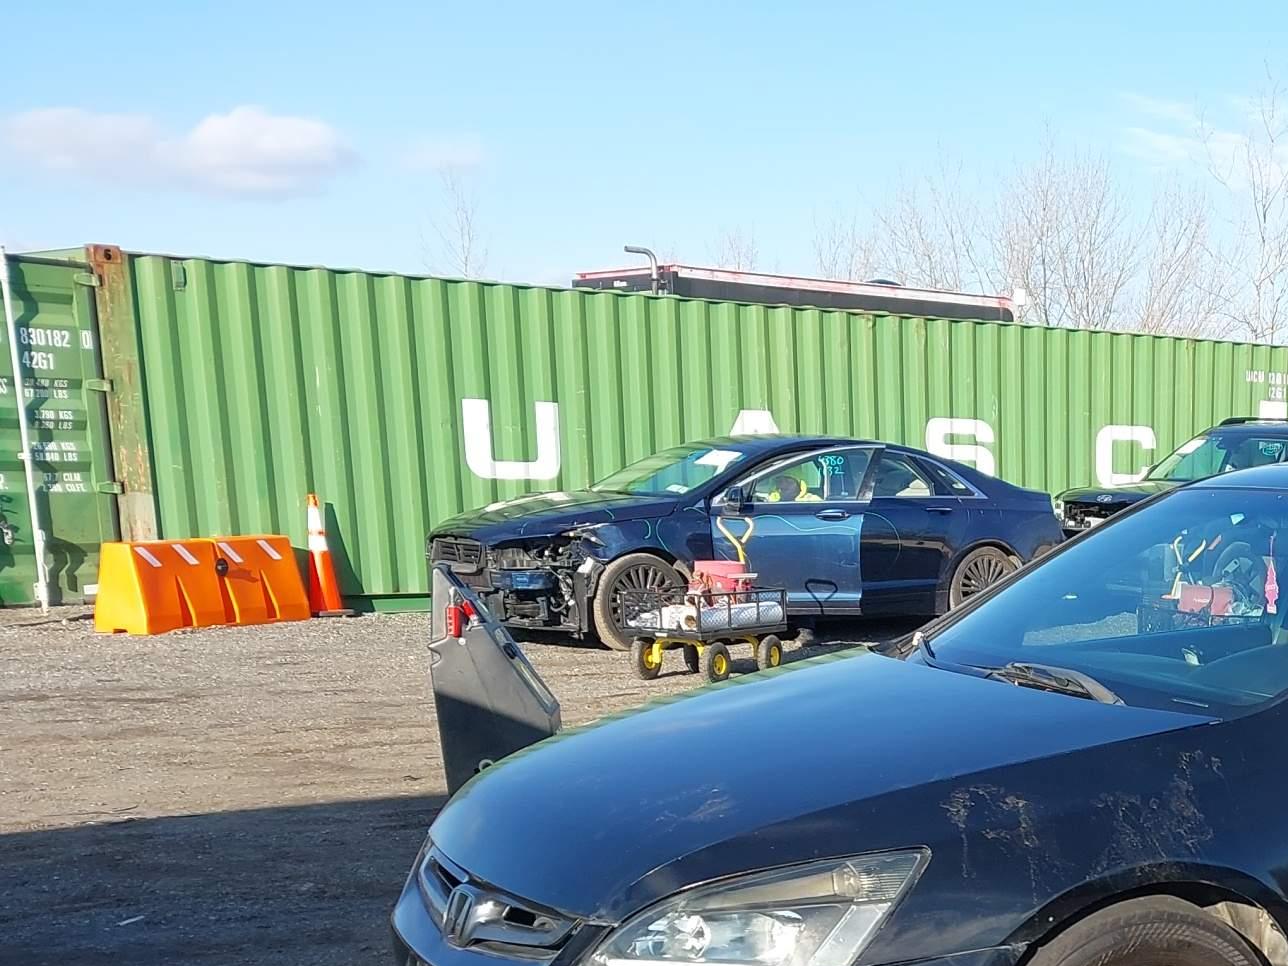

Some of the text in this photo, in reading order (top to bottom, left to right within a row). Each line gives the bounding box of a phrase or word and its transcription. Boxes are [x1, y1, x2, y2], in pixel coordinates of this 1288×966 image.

[20, 327, 72, 348] 830182
[22, 351, 55, 370] 42G1
[53, 388, 69, 399] LBS
[58, 410, 74, 420] KGS
[58, 421, 73, 430] LBS
[63, 452, 78, 461] LBS
